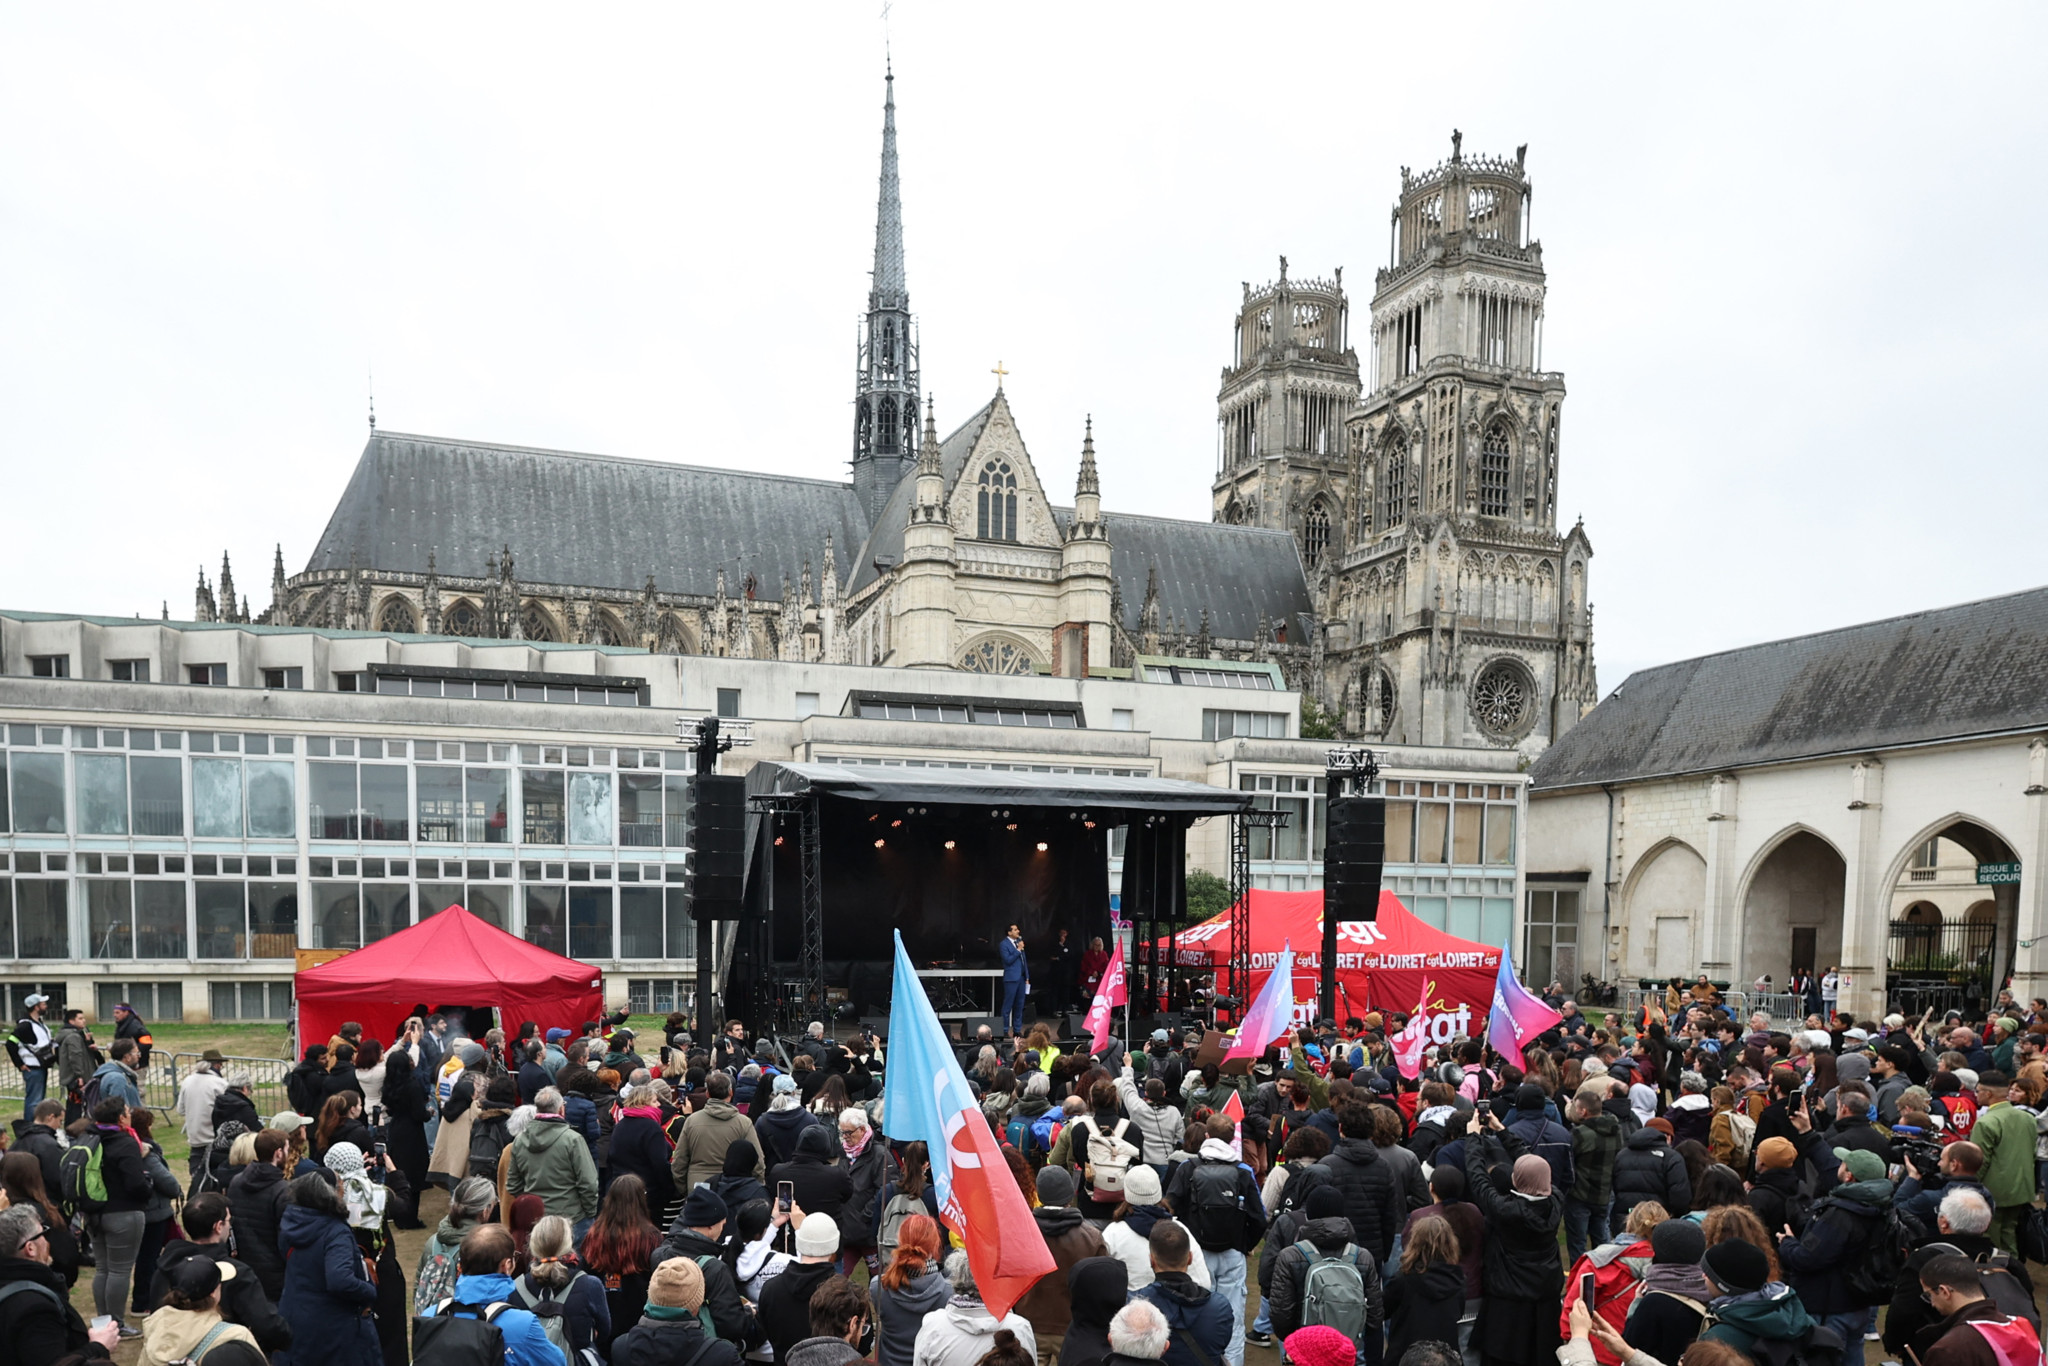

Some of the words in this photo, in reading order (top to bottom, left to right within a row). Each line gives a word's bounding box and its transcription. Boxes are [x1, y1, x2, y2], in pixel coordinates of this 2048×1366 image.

[1980, 864, 2009, 873] ISSUE
[2013, 863, 2021, 872] D
[1979, 873, 2021, 883] SECOUR
[1311, 951, 1365, 969] LRET
[1364, 956, 1379, 968] cgt
[1380, 953, 1427, 969] LOIRET
[1426, 955, 1440, 967] cgt
[1439, 951, 1485, 968] LOIRET
[1484, 955, 1498, 967] cgt
[1952, 1109, 1970, 1129] cgt
